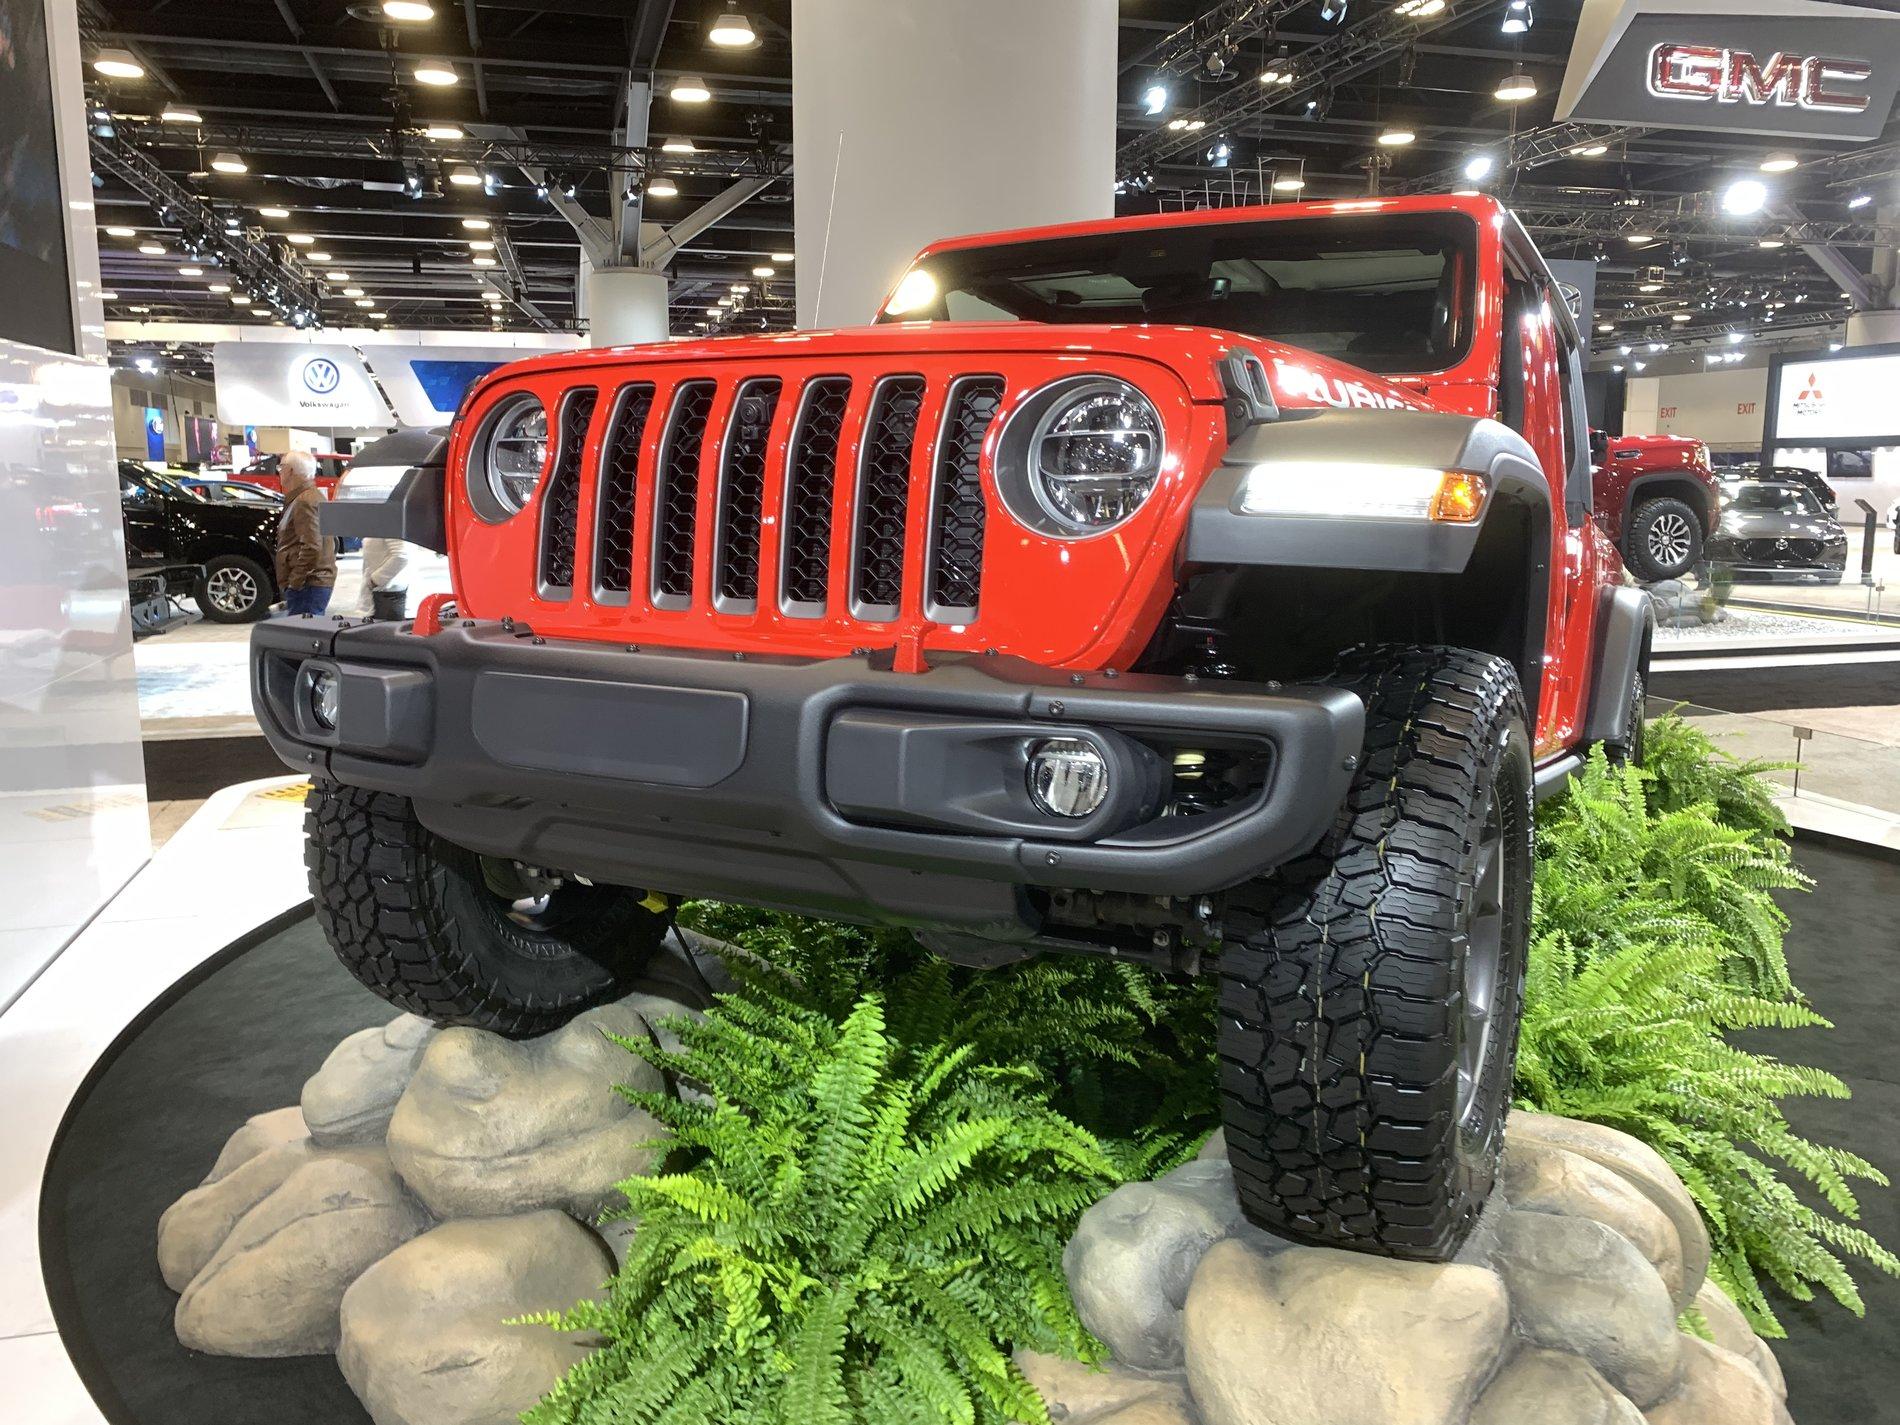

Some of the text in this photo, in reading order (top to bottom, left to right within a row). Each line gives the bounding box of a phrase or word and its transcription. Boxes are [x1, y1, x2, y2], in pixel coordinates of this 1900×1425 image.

[1646, 42, 1872, 113] GMC
[1660, 407, 1677, 418] EXIT
[1737, 403, 1756, 415] EXIT
